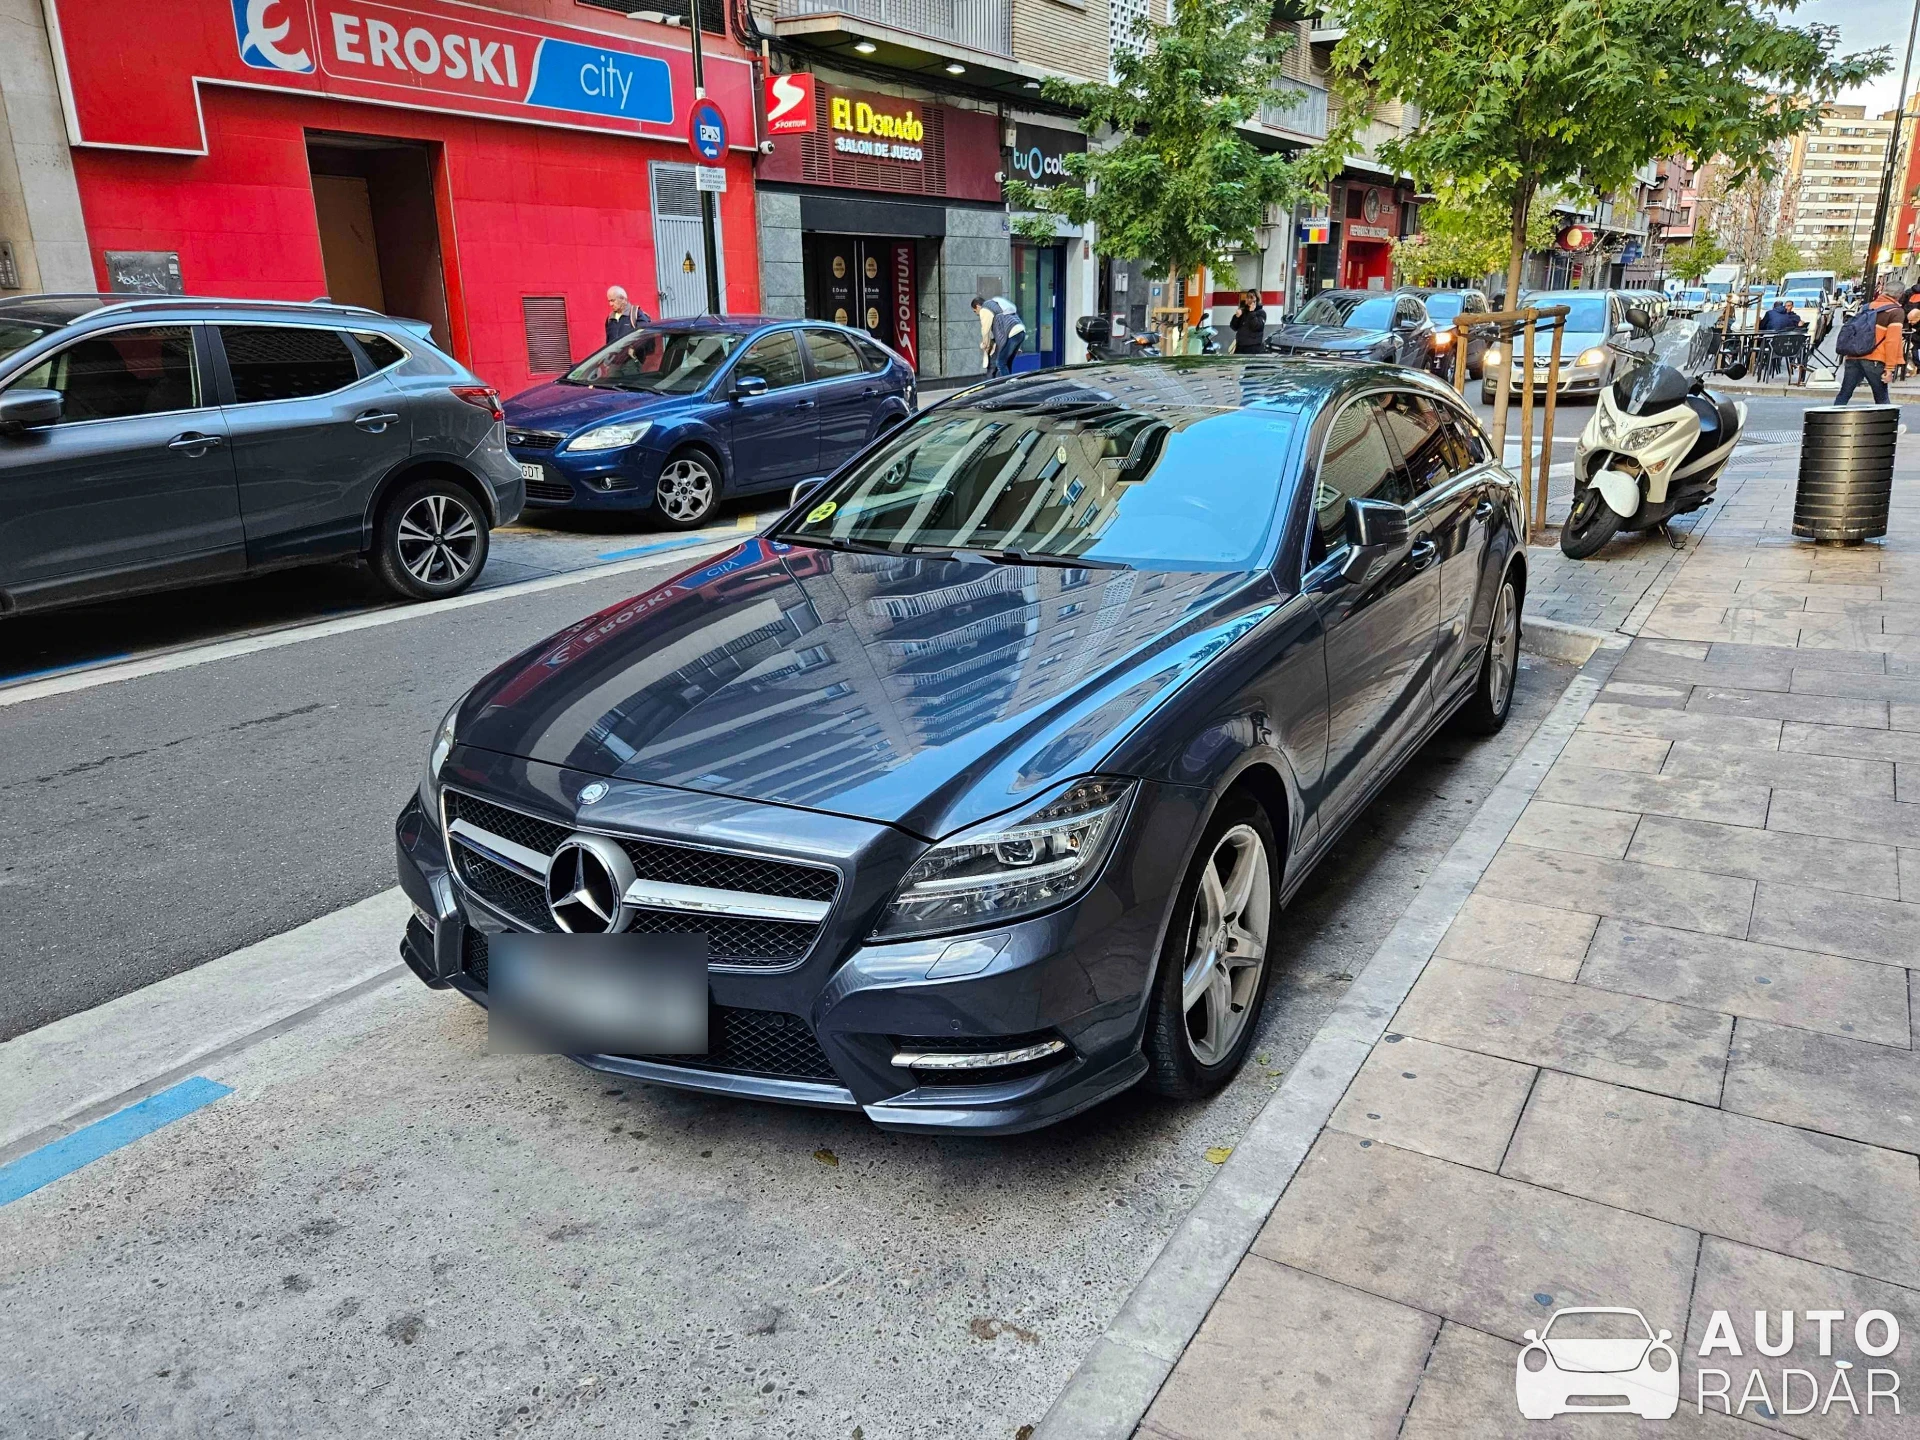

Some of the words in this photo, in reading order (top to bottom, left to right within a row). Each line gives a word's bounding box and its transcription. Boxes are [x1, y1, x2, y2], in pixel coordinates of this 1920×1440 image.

[330, 12, 519, 87] EROSKI
[580, 55, 634, 110] city
[771, 120, 807, 131] SPORTIUM
[876, 142, 888, 157] DE
[891, 145, 923, 161] JUEGO
[896, 248, 915, 362] SPORTIUM
[521, 465, 540, 479] GDT
